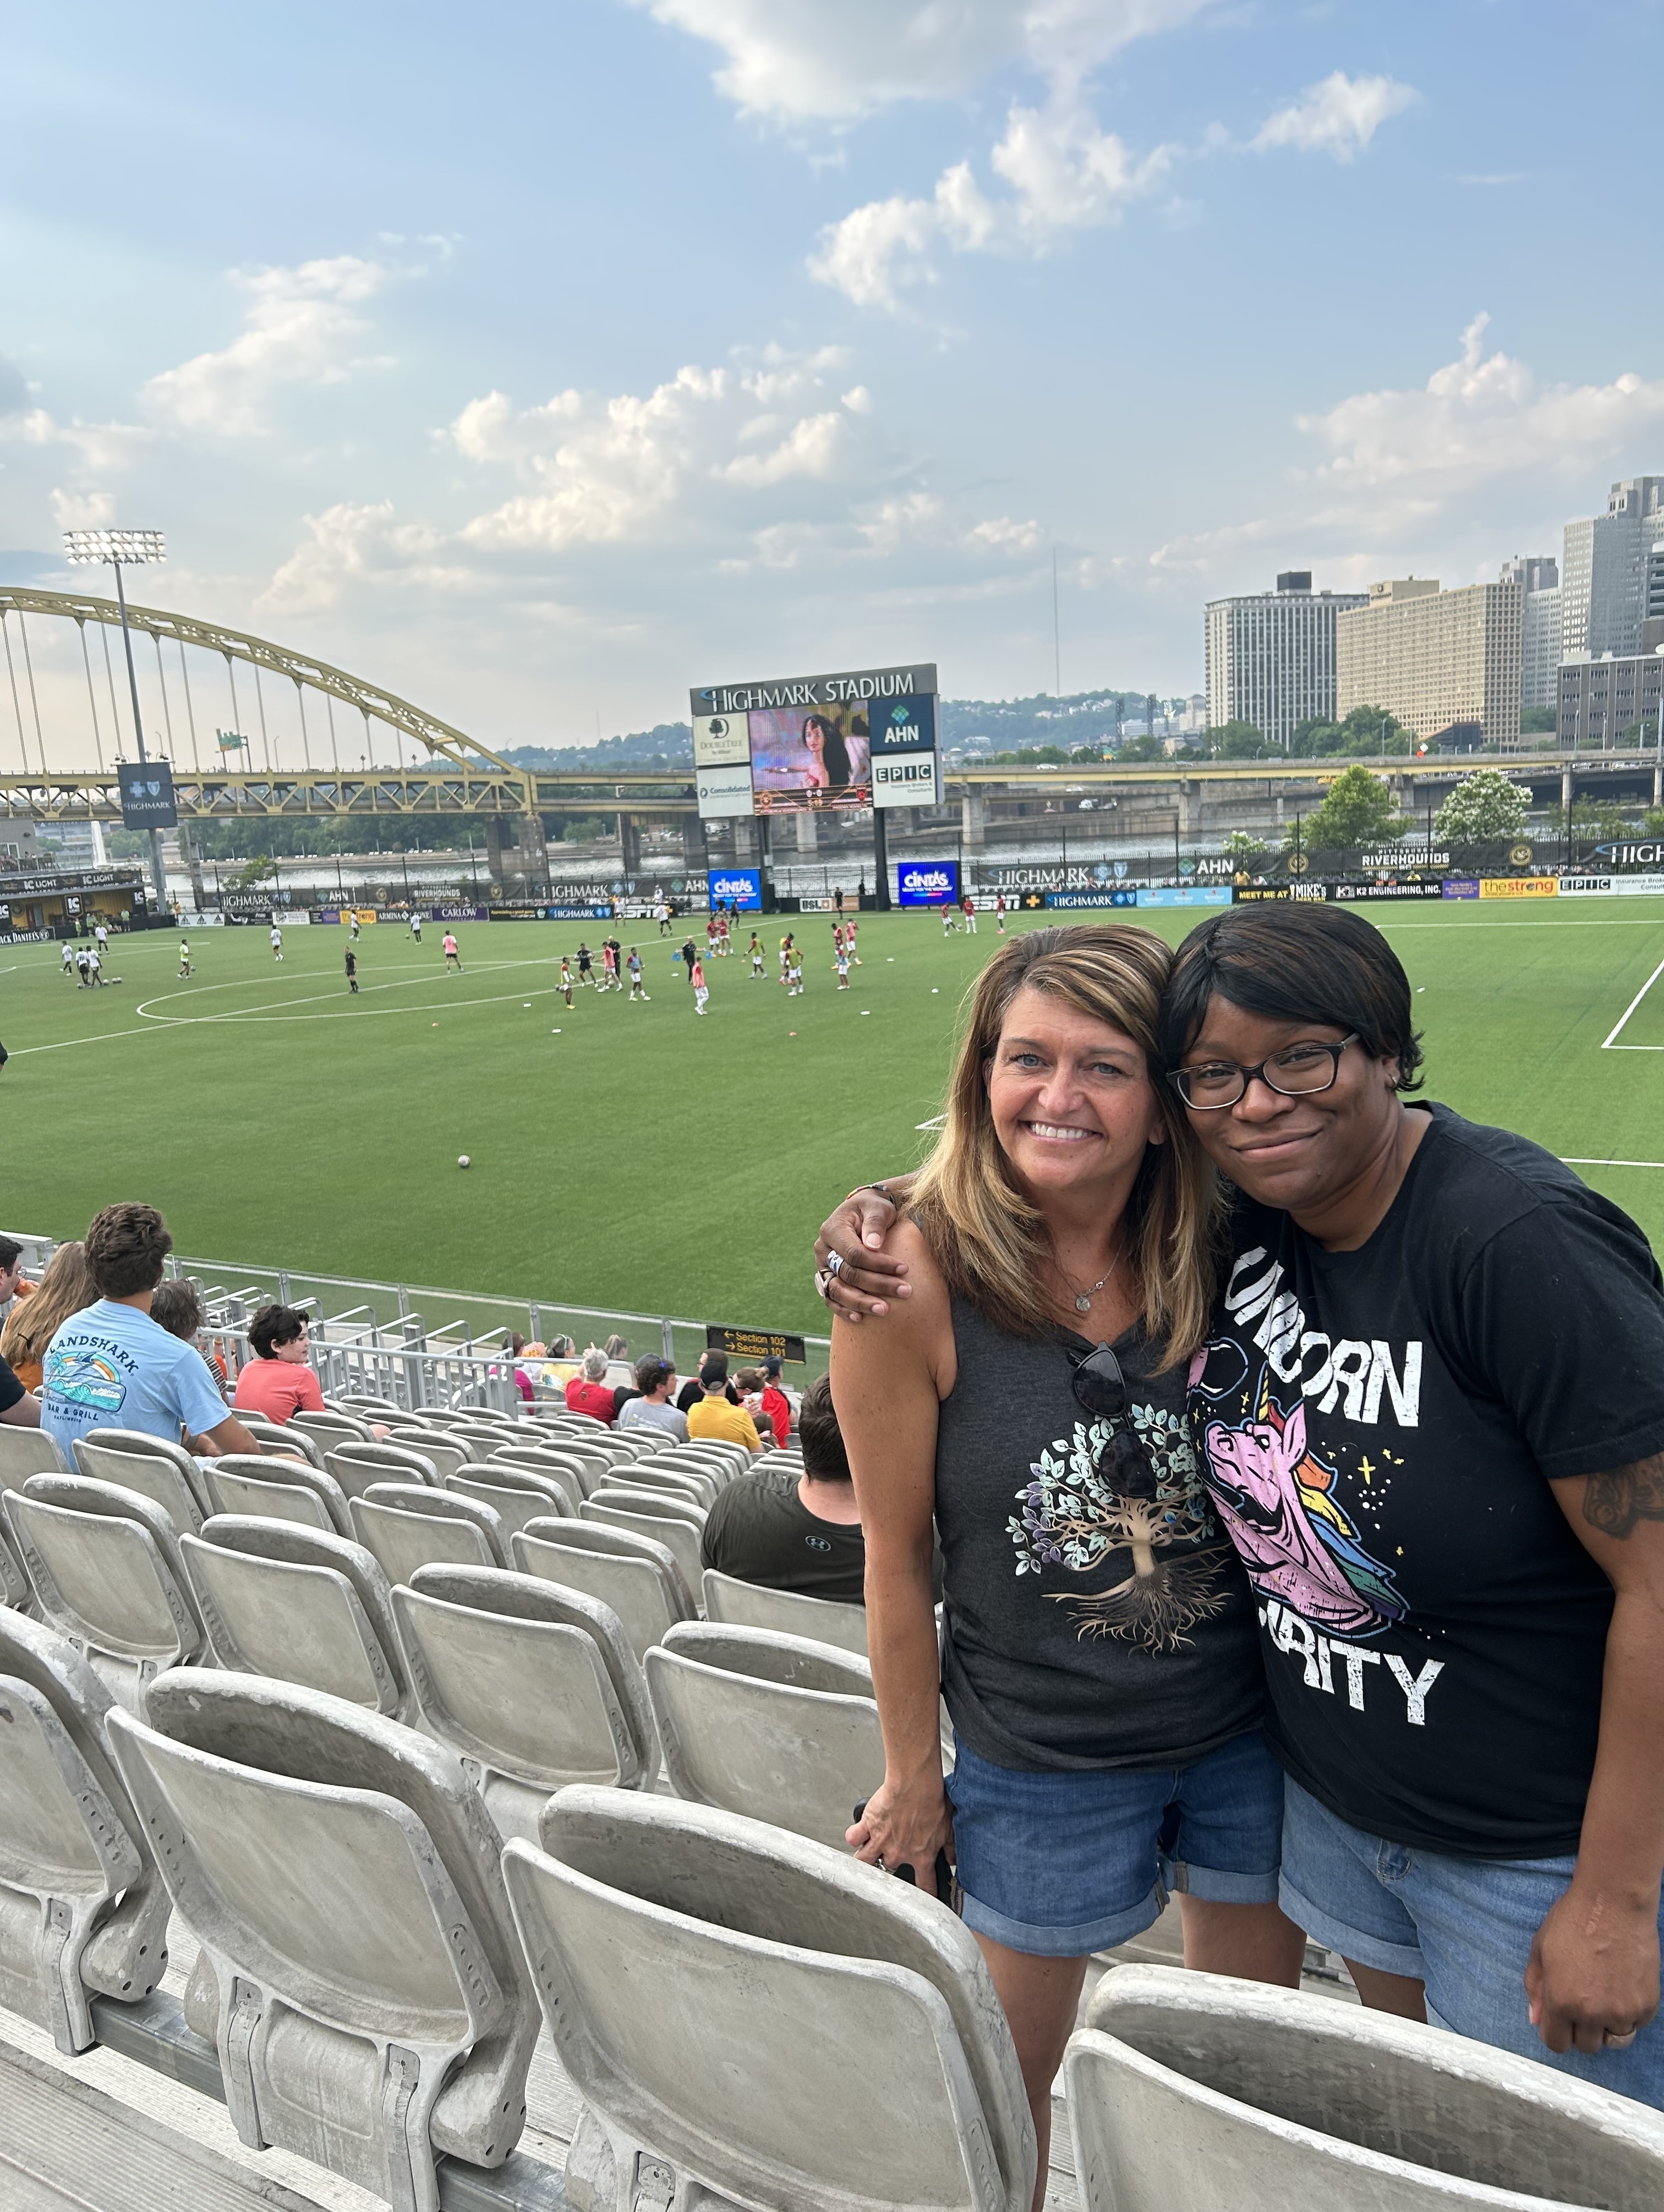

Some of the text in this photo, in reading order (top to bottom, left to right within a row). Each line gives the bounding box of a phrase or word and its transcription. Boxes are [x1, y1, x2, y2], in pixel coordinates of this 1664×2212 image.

[712, 673, 914, 712] HIGHMARK STADIUM
[884, 725, 919, 743] AHN
[877, 766, 930, 781] EPIC
[710, 785, 751, 794] Consolidated
[127, 801, 171, 811] HIGHMARK
[1362, 852, 1450, 866] RIVERHOUNDS
[1197, 858, 1234, 875] AHN
[83, 875, 92, 885] IC
[93, 874, 113, 883] LIGHT
[998, 866, 1089, 885] HIGHMARK
[24, 880, 35, 890] IC
[35, 879, 57, 888] LIGHT
[685, 880, 709, 892] AHN
[1356, 887, 1367, 896] K2
[1369, 885, 1424, 896] ENGINEERING,
[1425, 885, 1441, 894] INC.
[1561, 880, 1610, 889] EPIC
[134, 891, 144, 901] IC
[330, 890, 349, 902] AHN
[414, 888, 461, 898] RIVERHOUNDS
[1239, 890, 1289, 900] MEET ME AT
[68, 897, 80, 909] IC
[802, 899, 822, 910] USL
[1053, 895, 1112, 907] HIGHMARK
[441, 908, 478, 918] CARLOW
[553, 909, 595, 919] HIGHMARK
[0, 935, 12, 945] ACK
[12, 930, 40, 943] DANIEL'S
[736, 1331, 786, 1346] Section 102
[50, 1336, 139, 1374] LANDSHARK
[736, 1342, 786, 1357] Section 101
[48, 1403, 59, 1413] BAR
[73, 1409, 98, 1420] GRILL
